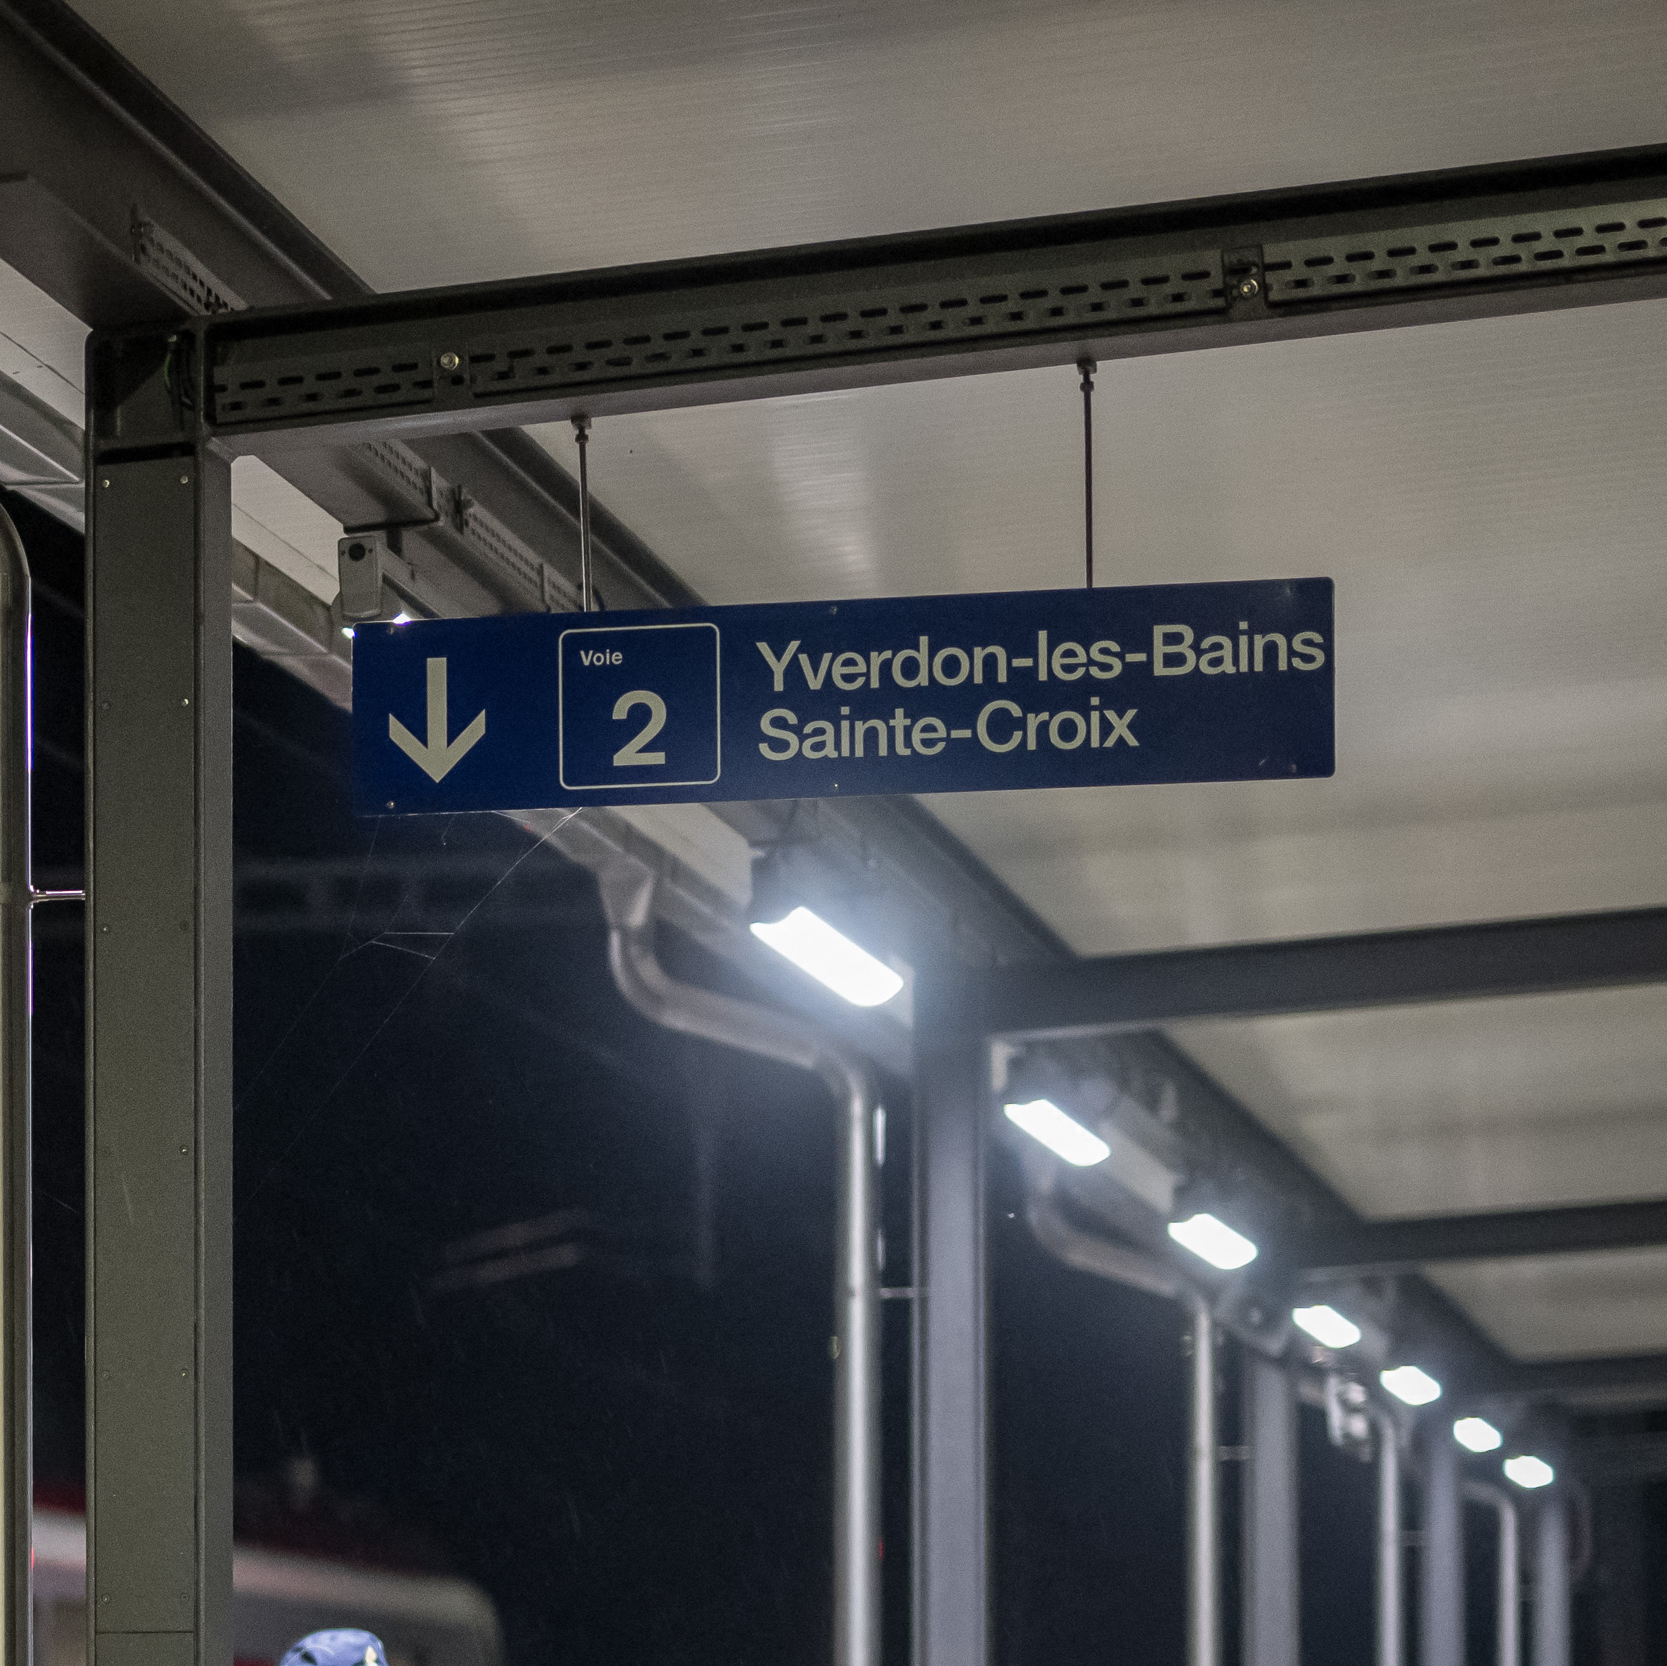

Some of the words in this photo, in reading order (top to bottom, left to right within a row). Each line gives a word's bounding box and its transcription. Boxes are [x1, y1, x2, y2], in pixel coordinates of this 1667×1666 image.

[579, 647, 623, 667] Voie
[756, 622, 1325, 694] Yverdon-les-Bains
[611, 689, 666, 767] 2
[757, 695, 1140, 763] Sainte-Croix
